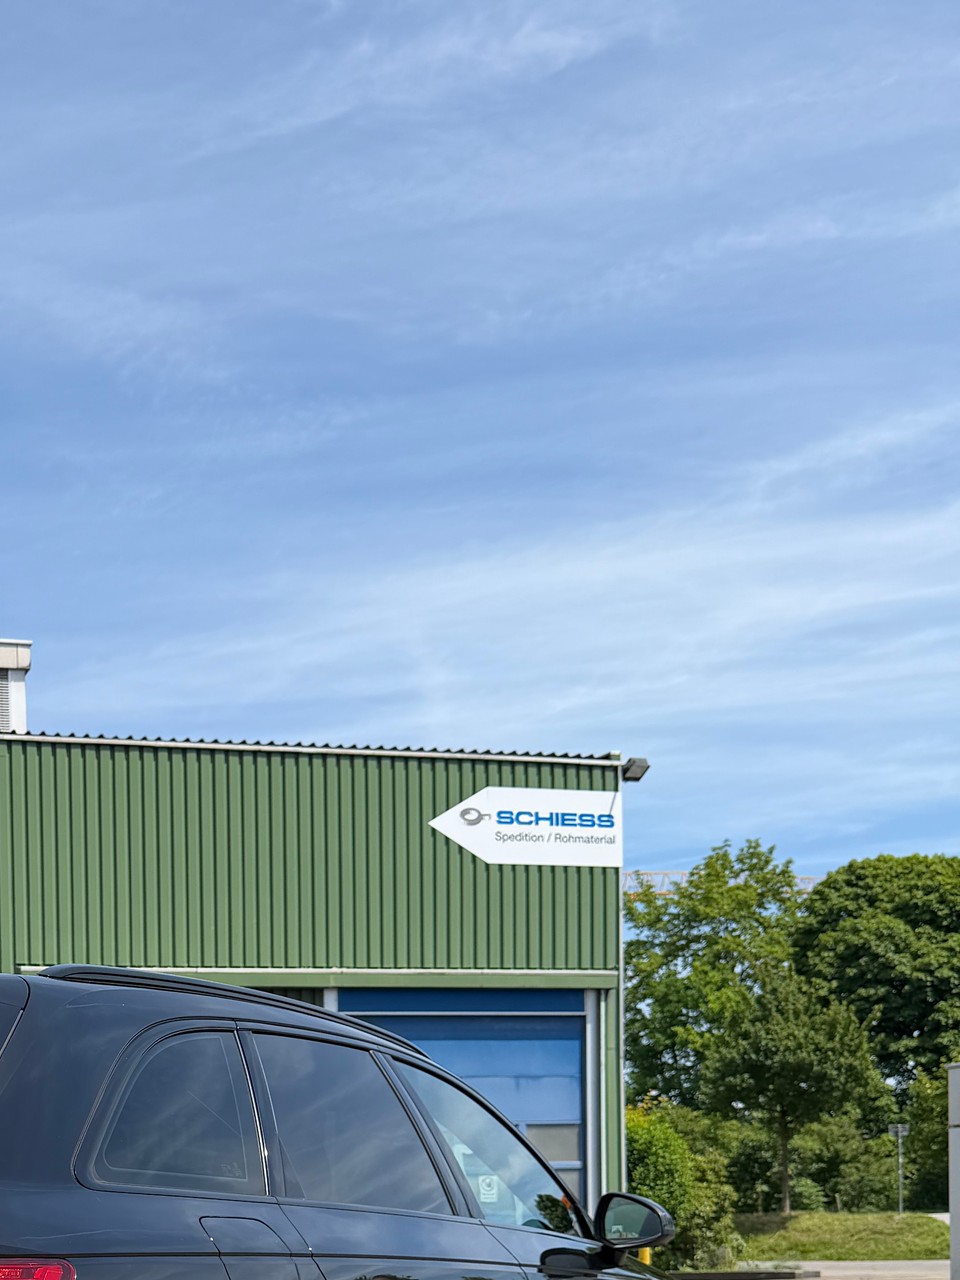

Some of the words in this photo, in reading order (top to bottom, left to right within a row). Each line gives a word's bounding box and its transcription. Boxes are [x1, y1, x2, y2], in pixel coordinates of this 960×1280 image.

[496, 810, 615, 828] SCHIESS
[495, 831, 544, 843] Spedition
[554, 832, 615, 844] Rohmaterial
